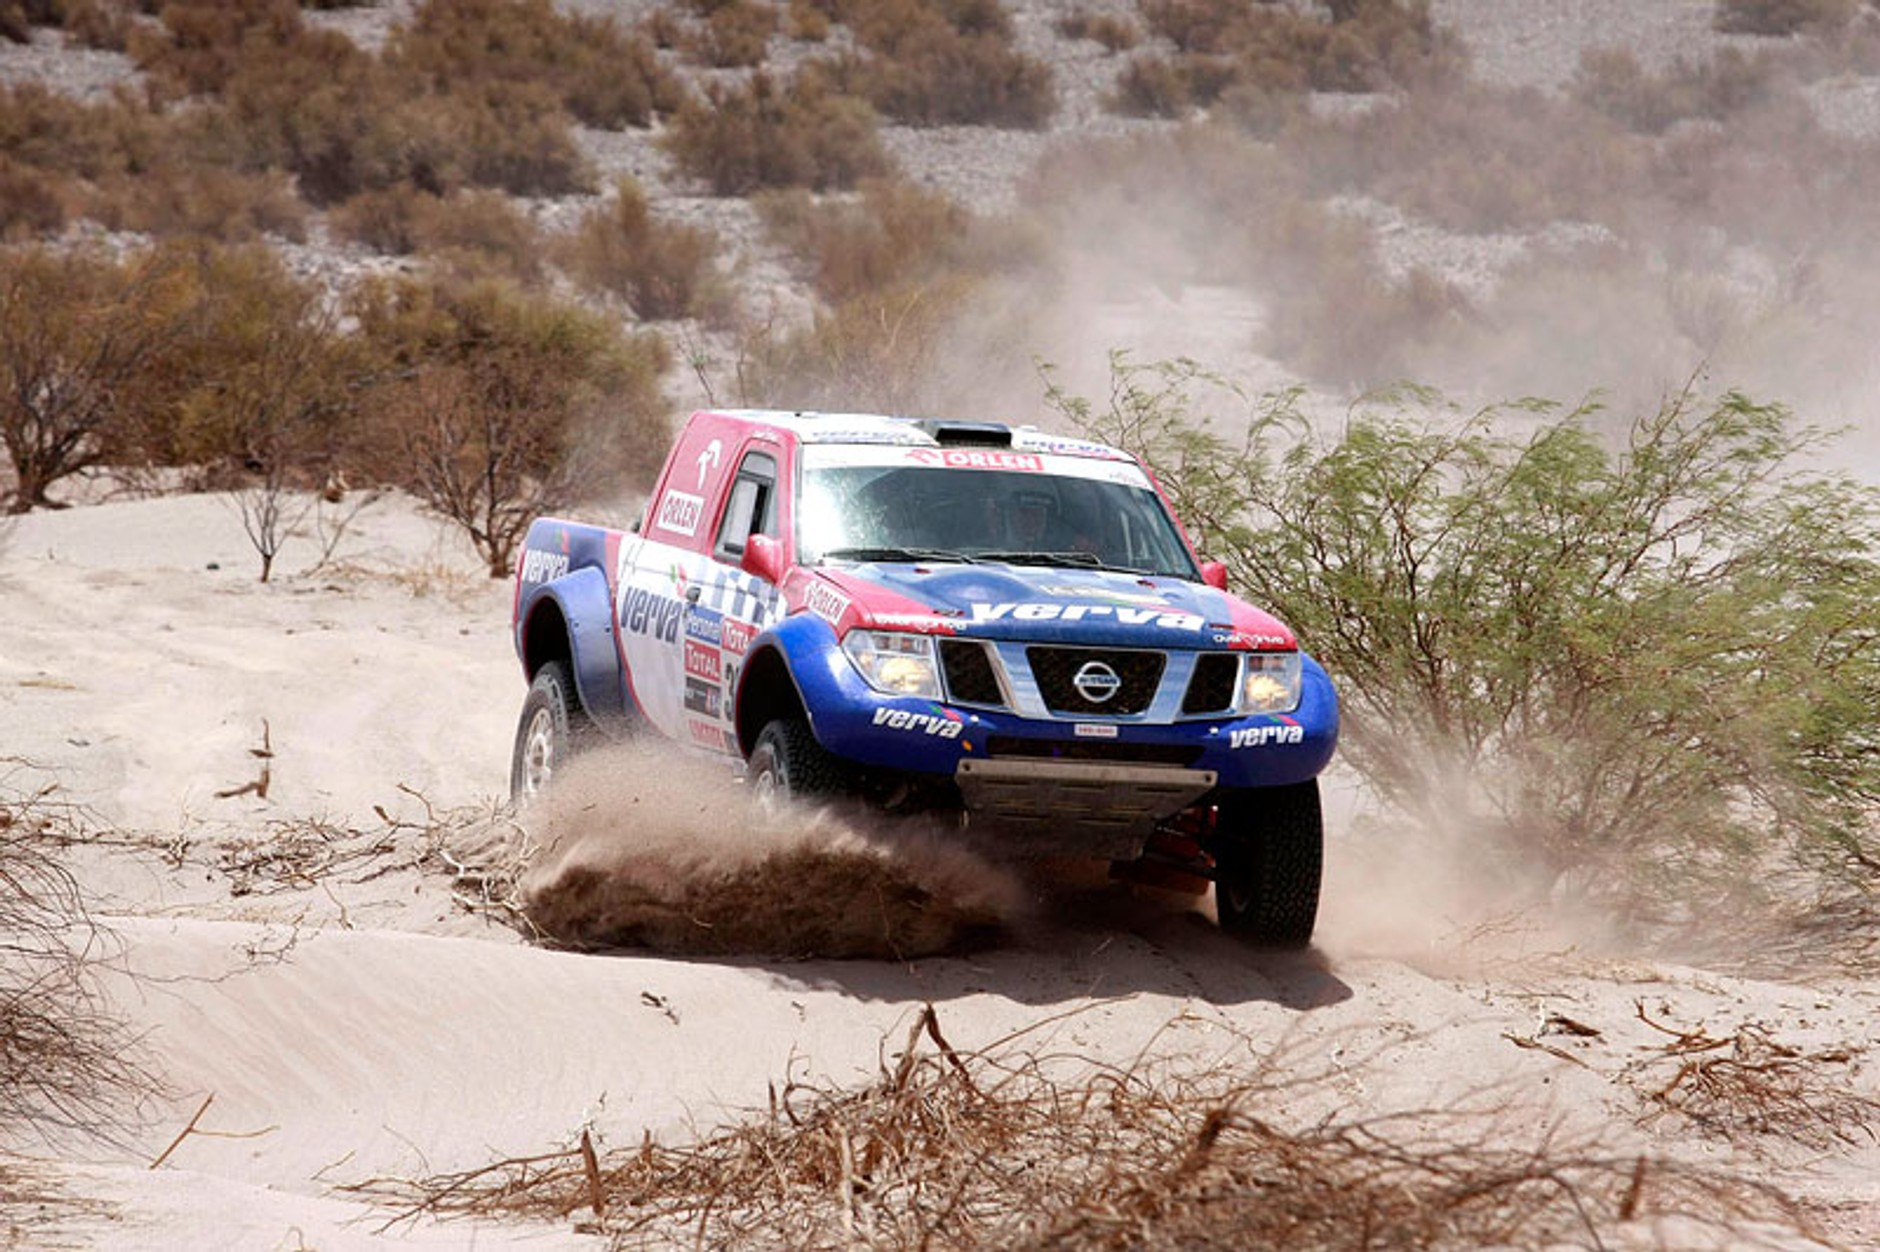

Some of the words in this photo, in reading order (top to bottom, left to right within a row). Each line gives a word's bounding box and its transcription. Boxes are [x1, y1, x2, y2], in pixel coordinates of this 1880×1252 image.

[950, 451, 1039, 470] ORLEN
[662, 495, 700, 528] ORLEN
[620, 586, 683, 644] verva
[971, 603, 1205, 631] verva
[686, 643, 720, 678] TOTAL
[872, 707, 964, 738] verva
[1230, 725, 1304, 748] verva
